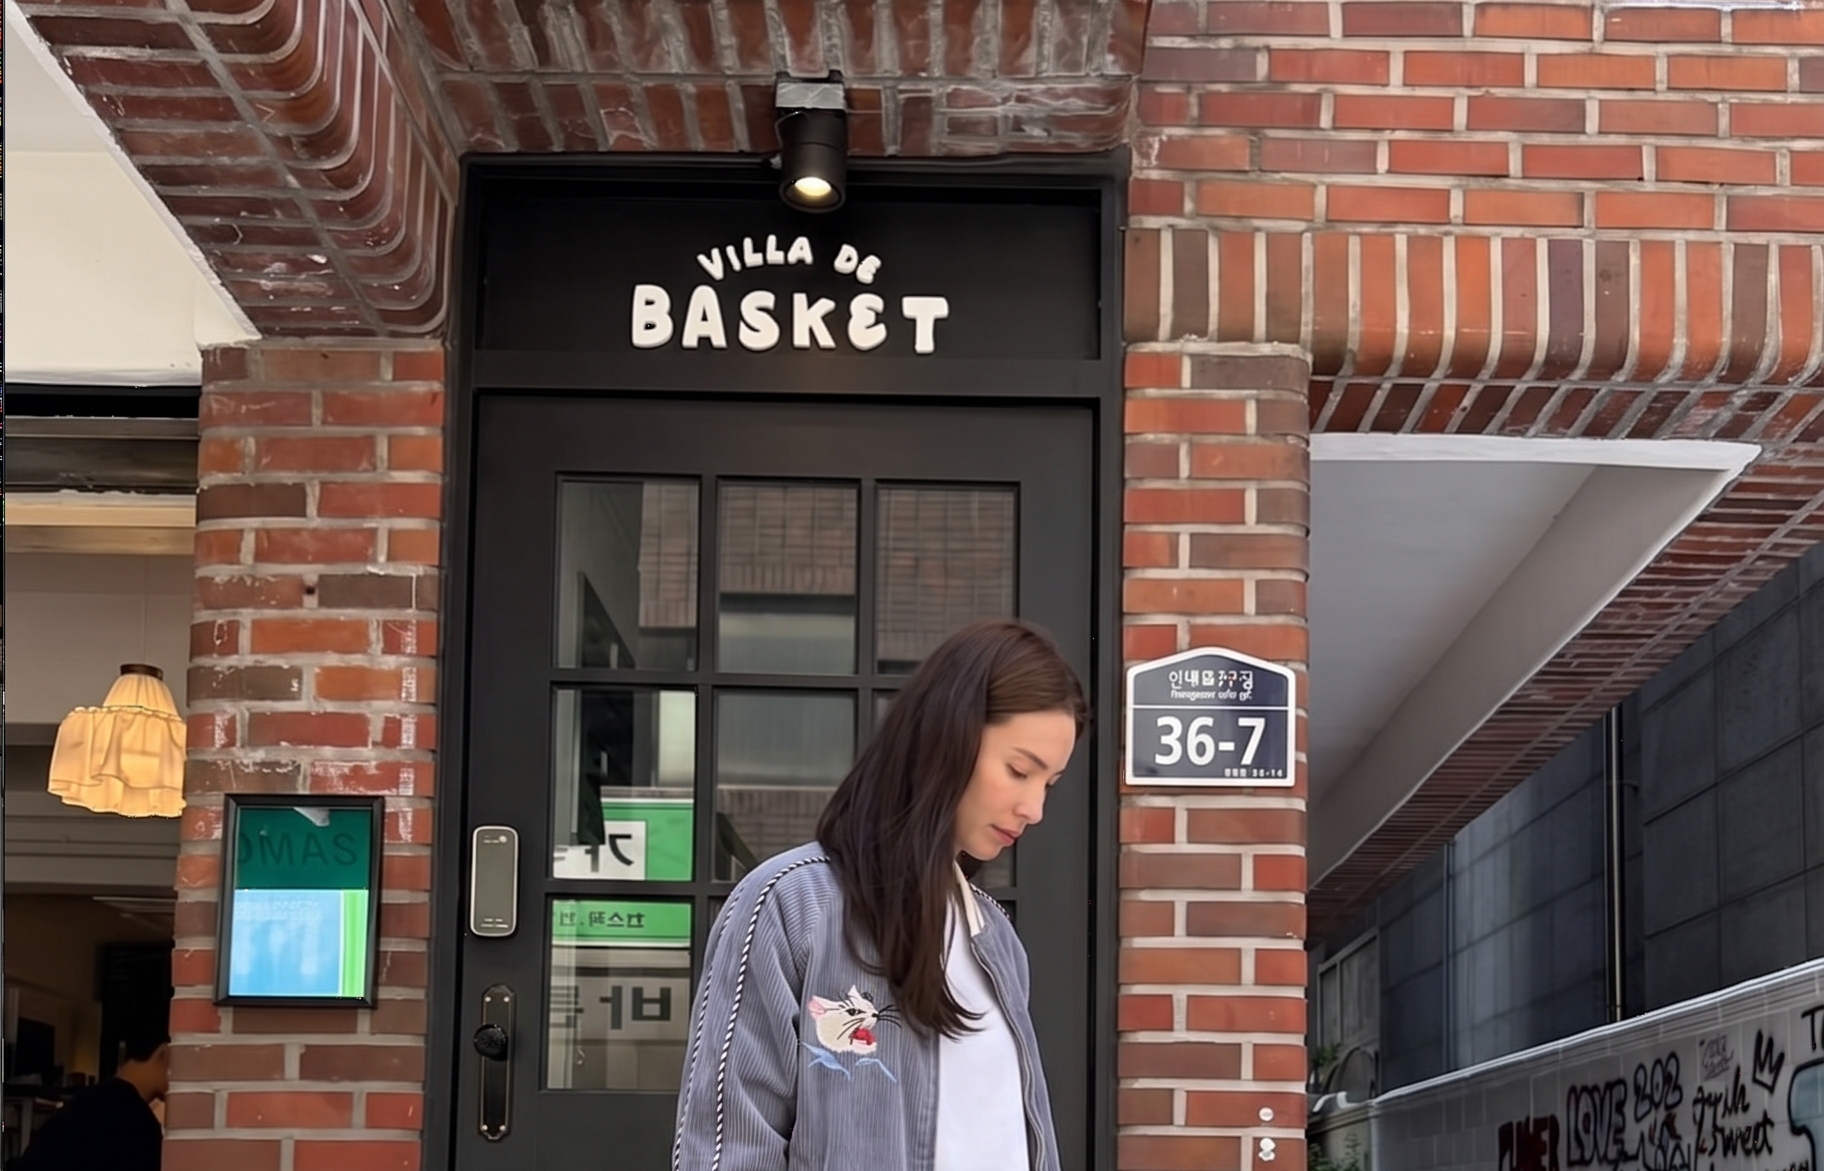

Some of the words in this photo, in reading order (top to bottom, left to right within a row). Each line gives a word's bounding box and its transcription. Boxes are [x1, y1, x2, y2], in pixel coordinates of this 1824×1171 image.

[697, 235, 813, 280] VILLA
[834, 244, 881, 284] DE
[632, 284, 948, 353] BASKET
[1155, 716, 1266, 766] 36-7
[1567, 1078, 1628, 1168] LOVE
